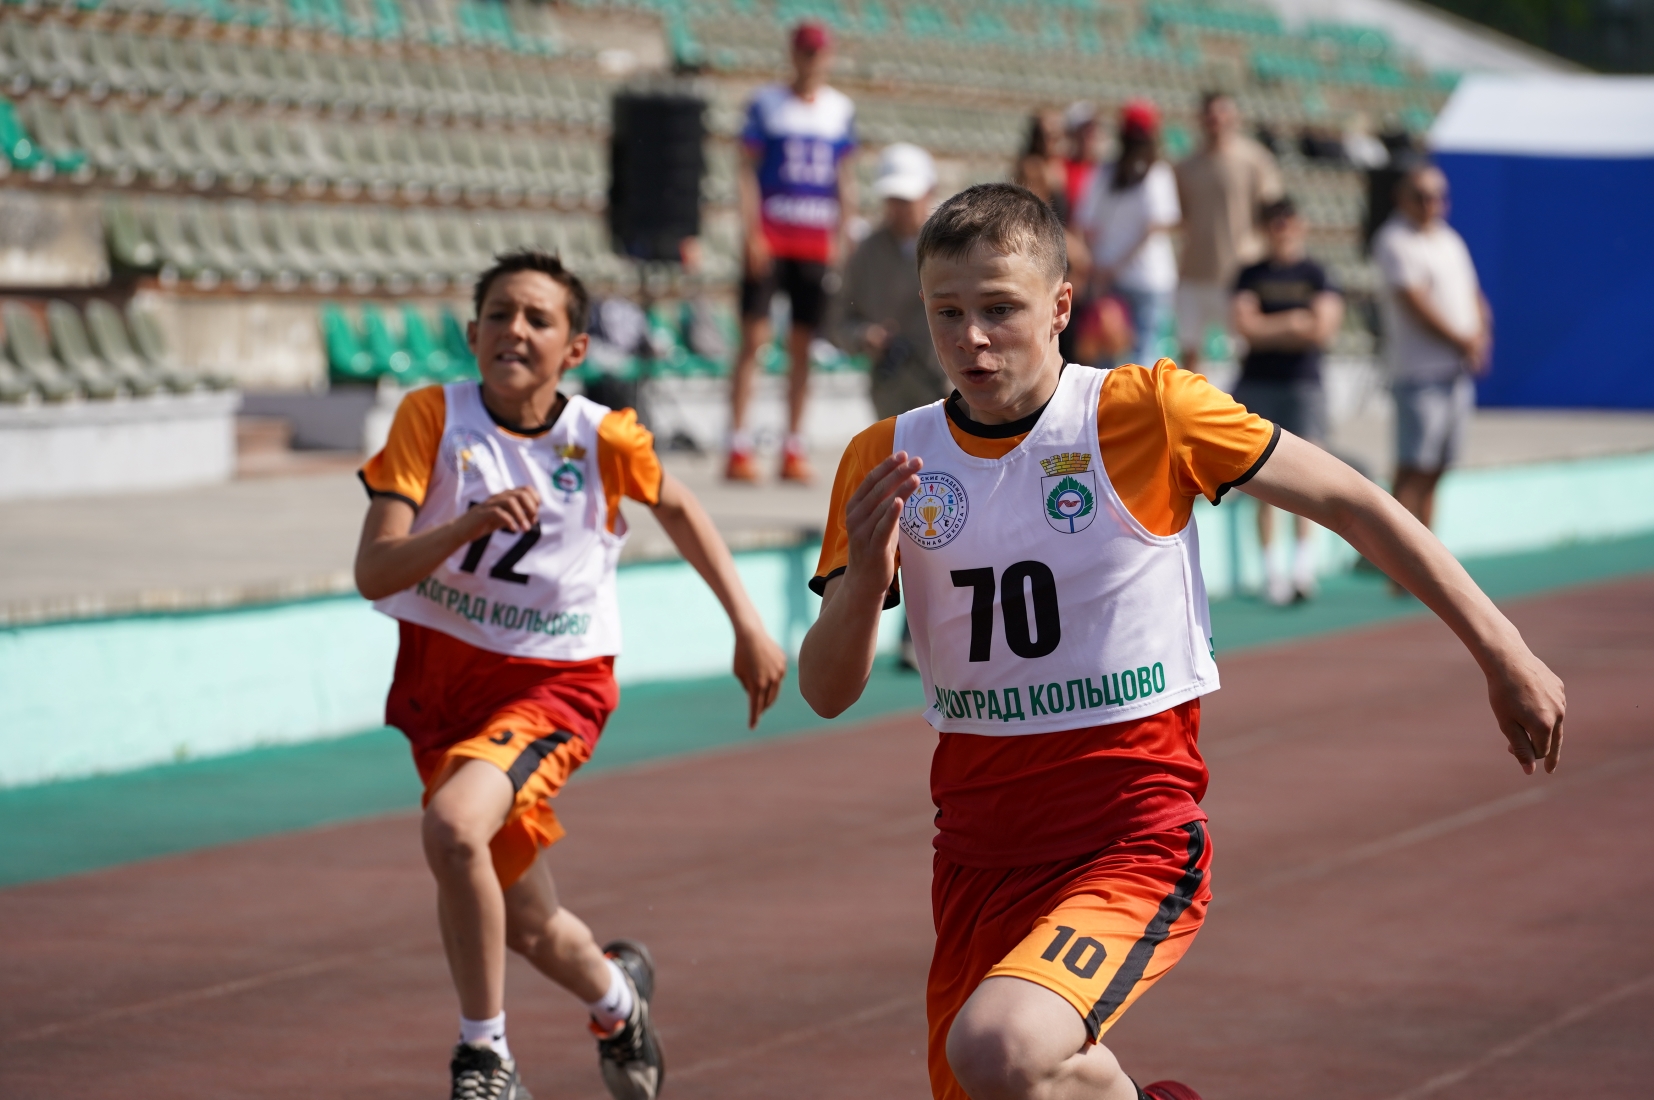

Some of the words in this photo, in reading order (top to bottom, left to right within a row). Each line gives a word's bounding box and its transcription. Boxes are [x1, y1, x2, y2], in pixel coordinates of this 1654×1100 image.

[941, 476, 964, 502] НАДЕЖДЫ
[899, 516, 942, 546] СПОРТИВНАЯ
[945, 512, 964, 539] ШКОЛА
[416, 575, 487, 624] КОГРАД
[949, 560, 1061, 662] 70
[1028, 661, 1166, 716] КОЛЬЦОВО
[1040, 925, 1107, 979] 10
